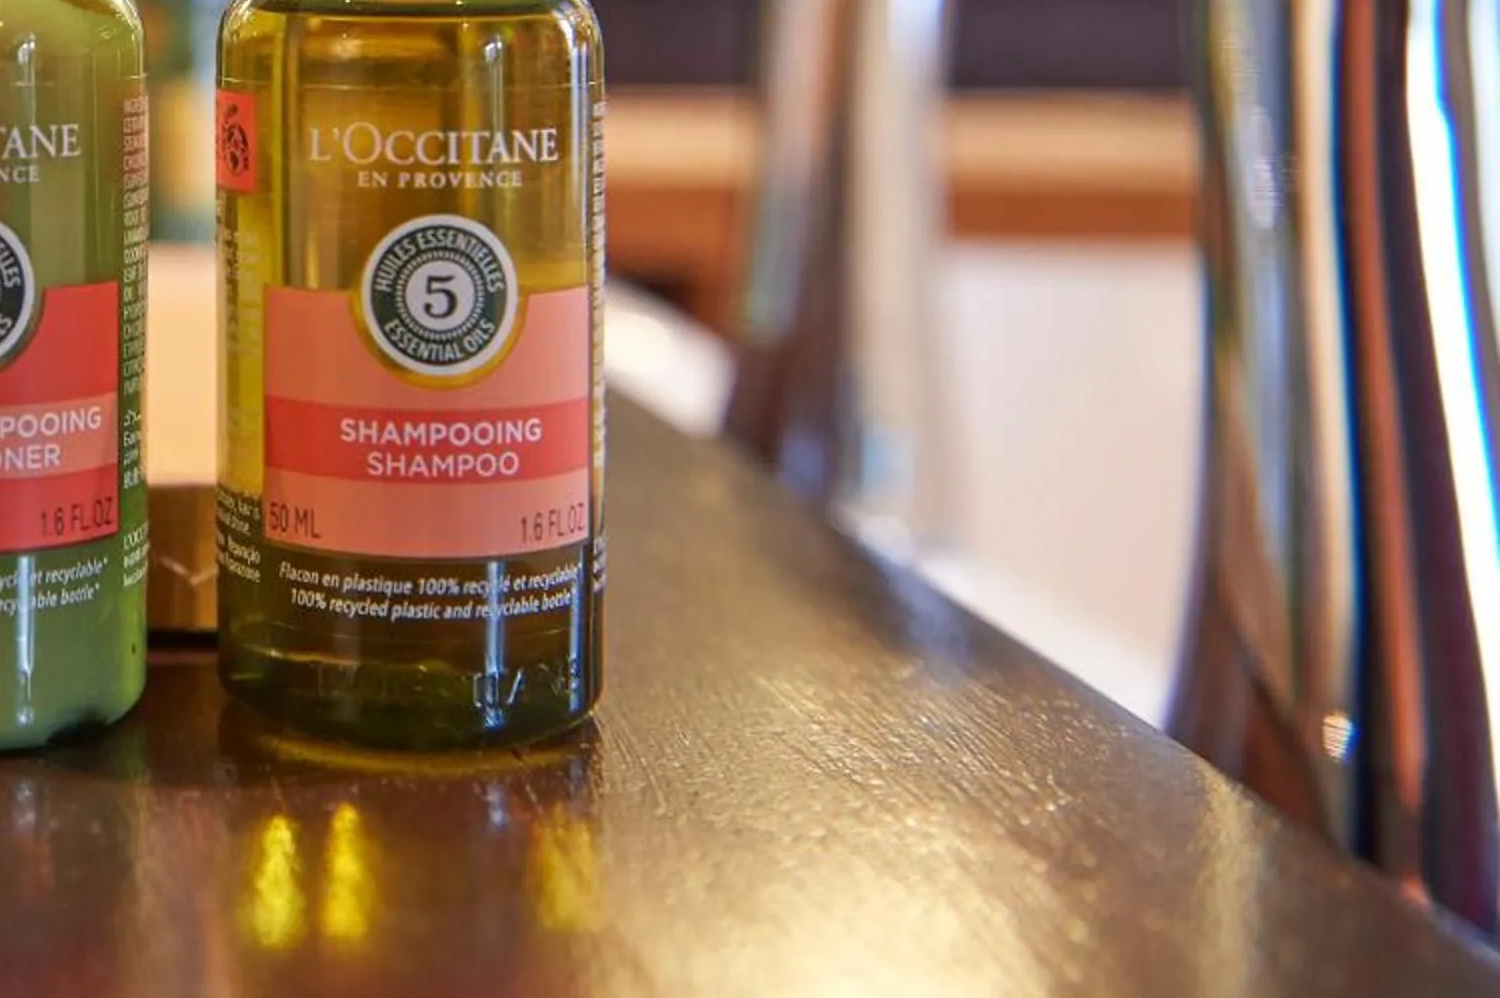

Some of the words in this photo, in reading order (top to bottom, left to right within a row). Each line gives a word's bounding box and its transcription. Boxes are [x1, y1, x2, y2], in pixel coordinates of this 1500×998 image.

[308, 121, 559, 165] L'OCCITANE
[358, 170, 388, 188] EN
[400, 170, 523, 189] PROVENCE
[374, 238, 417, 292] HUILES
[415, 228, 504, 293] ESSENTIELLES
[423, 274, 458, 319] 5
[384, 318, 465, 362] ESSENTIAL
[463, 318, 496, 352] OILS
[340, 418, 542, 447] SHAMPOOING
[367, 451, 520, 478] SHAMPOO
[269, 501, 289, 533] 50
[294, 507, 321, 539] ML
[279, 561, 318, 584] Flacon
[322, 573, 339, 588] en
[343, 573, 412, 597] plastique
[417, 577, 460, 596] 100%
[513, 574, 526, 591] et
[291, 588, 327, 610] 100%
[329, 597, 388, 619] recycled
[391, 599, 439, 622] plastic
[443, 601, 473, 619] and
